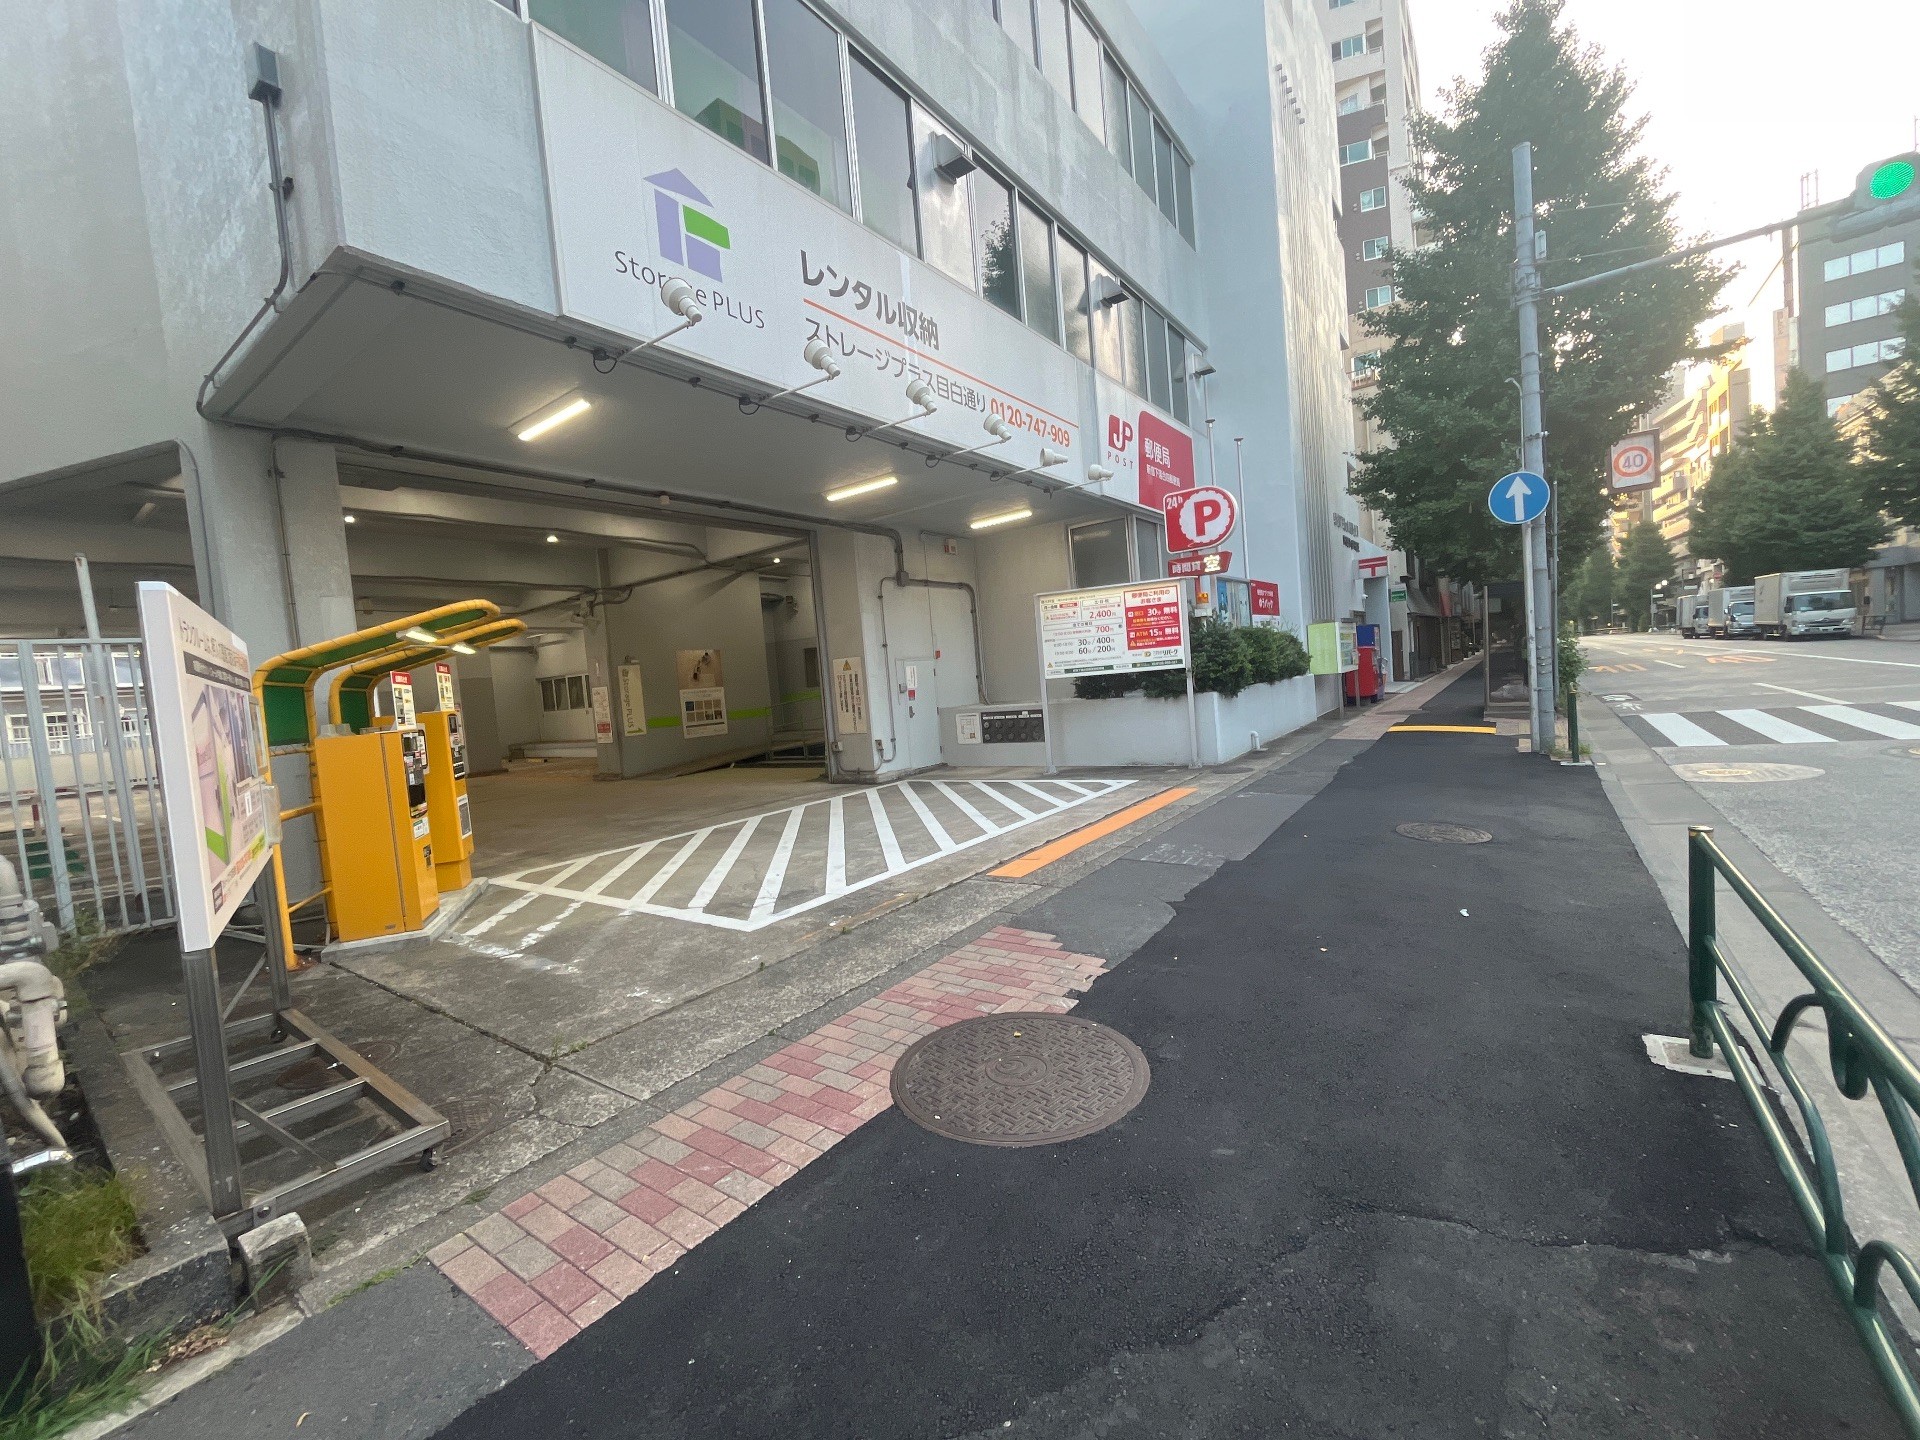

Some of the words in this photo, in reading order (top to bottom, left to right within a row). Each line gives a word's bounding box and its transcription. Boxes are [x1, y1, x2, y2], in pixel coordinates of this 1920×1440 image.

[614, 250, 707, 307] Store
[712, 290, 765, 329] PLUS
[800, 249, 940, 351] レンタル収納
[990, 397, 1071, 448] 0120-747-909
[1107, 451, 1134, 470] POST
[1144, 437, 1171, 469] 郵便局
[1622, 453, 1644, 470] 40
[1166, 495, 1183, 510] 24h
[1193, 499, 1222, 537] P
[1172, 561, 1201, 574] 時間貸
[1203, 554, 1221, 573] 空
